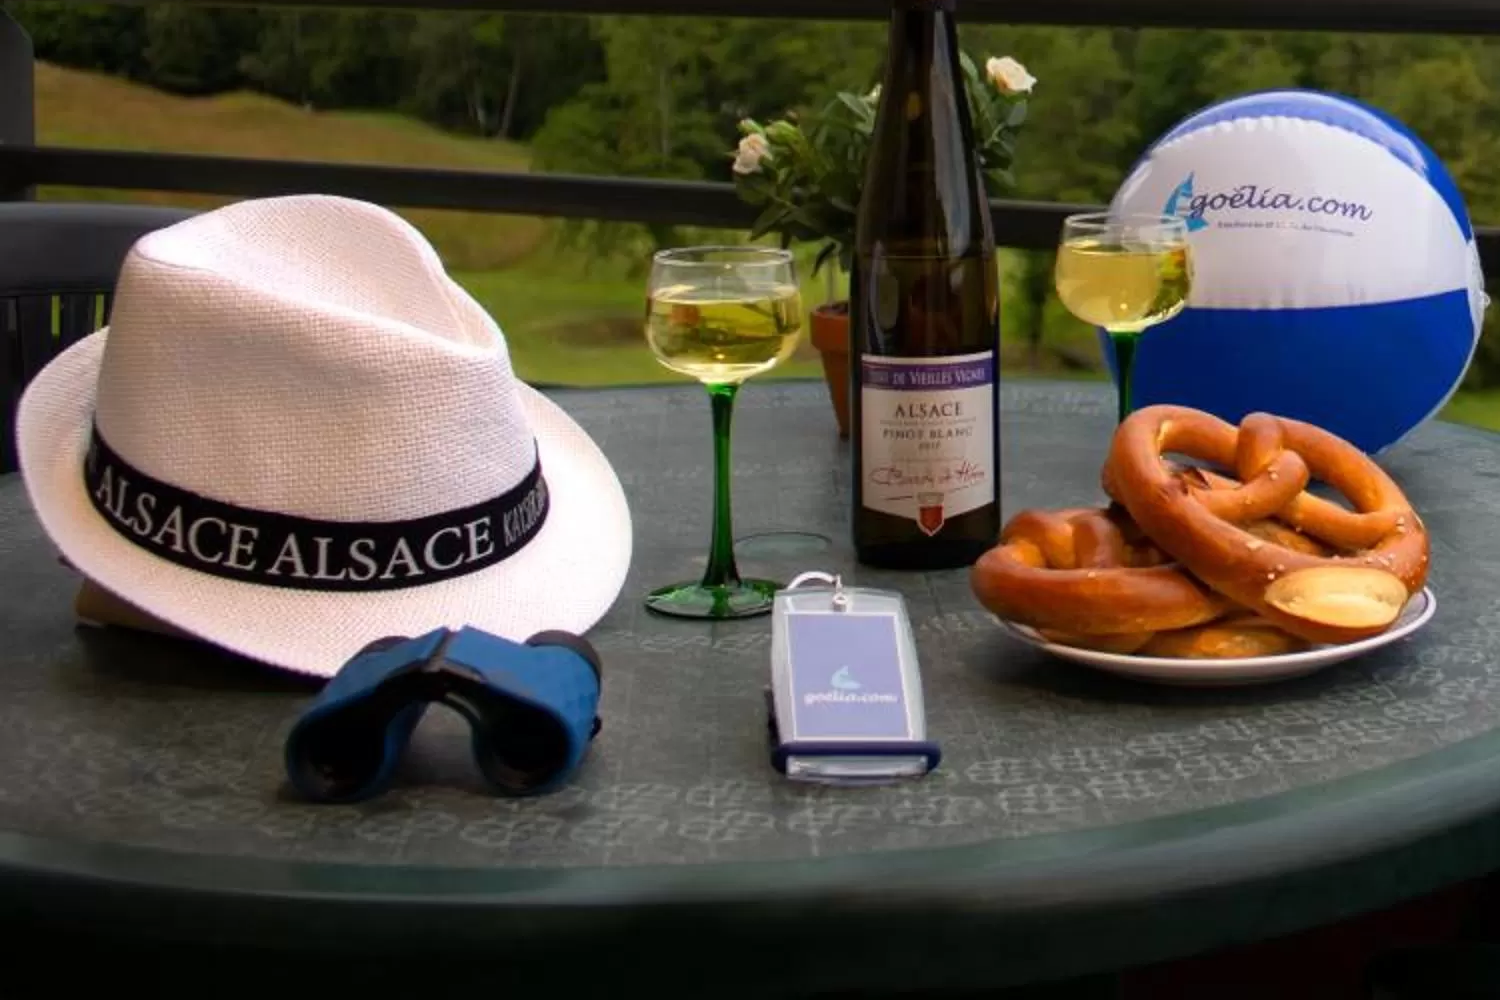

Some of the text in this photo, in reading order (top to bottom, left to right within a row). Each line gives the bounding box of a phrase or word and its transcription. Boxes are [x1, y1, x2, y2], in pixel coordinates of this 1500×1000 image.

[894, 402, 963, 418] ALSACE
[883, 426, 973, 439] PINOT BLANC
[96, 465, 260, 572] ALSACE
[265, 516, 495, 580] ALSACE
